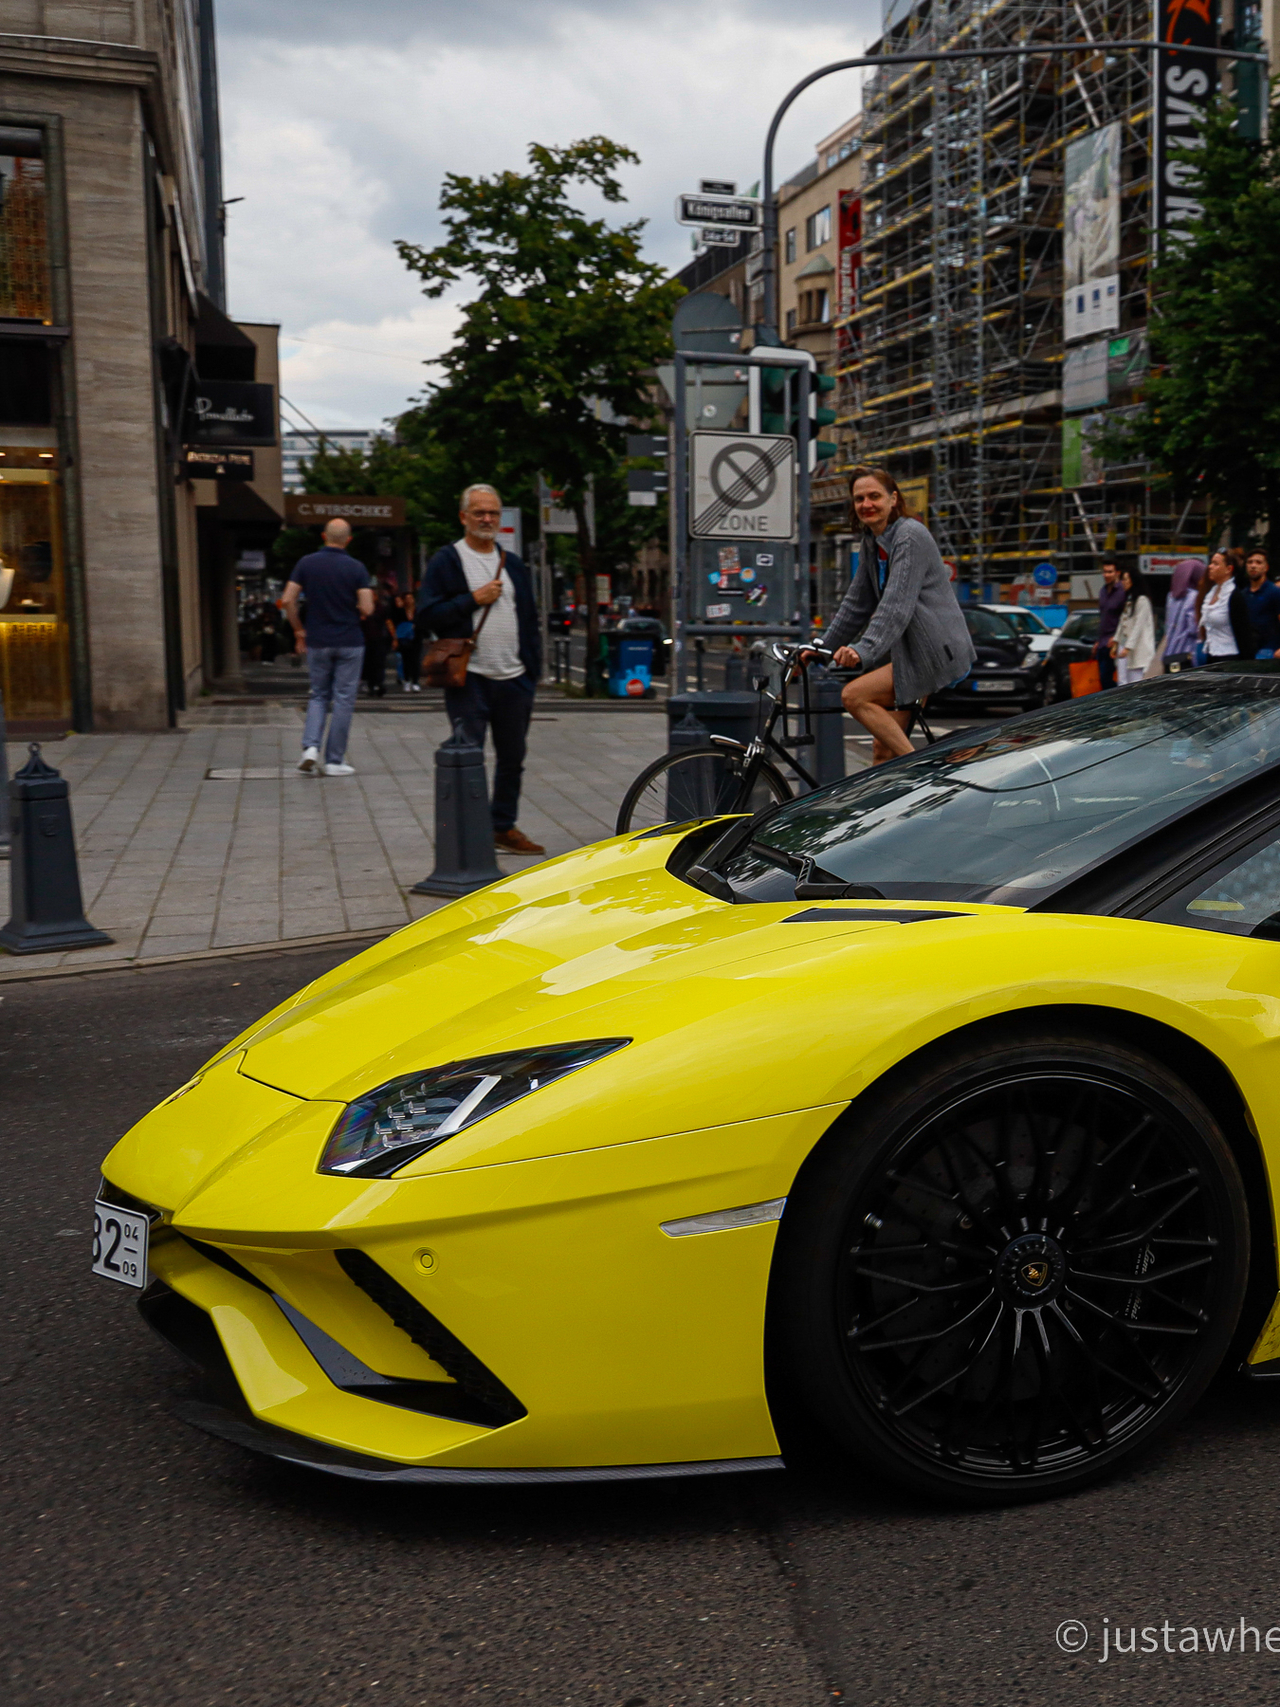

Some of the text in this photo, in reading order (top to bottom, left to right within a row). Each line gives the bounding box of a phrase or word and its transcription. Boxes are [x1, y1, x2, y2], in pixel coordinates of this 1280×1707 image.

[313, 503, 393, 518] WIRSCHKE
[718, 514, 768, 532] ZONE
[122, 1260, 137, 1278] 09
